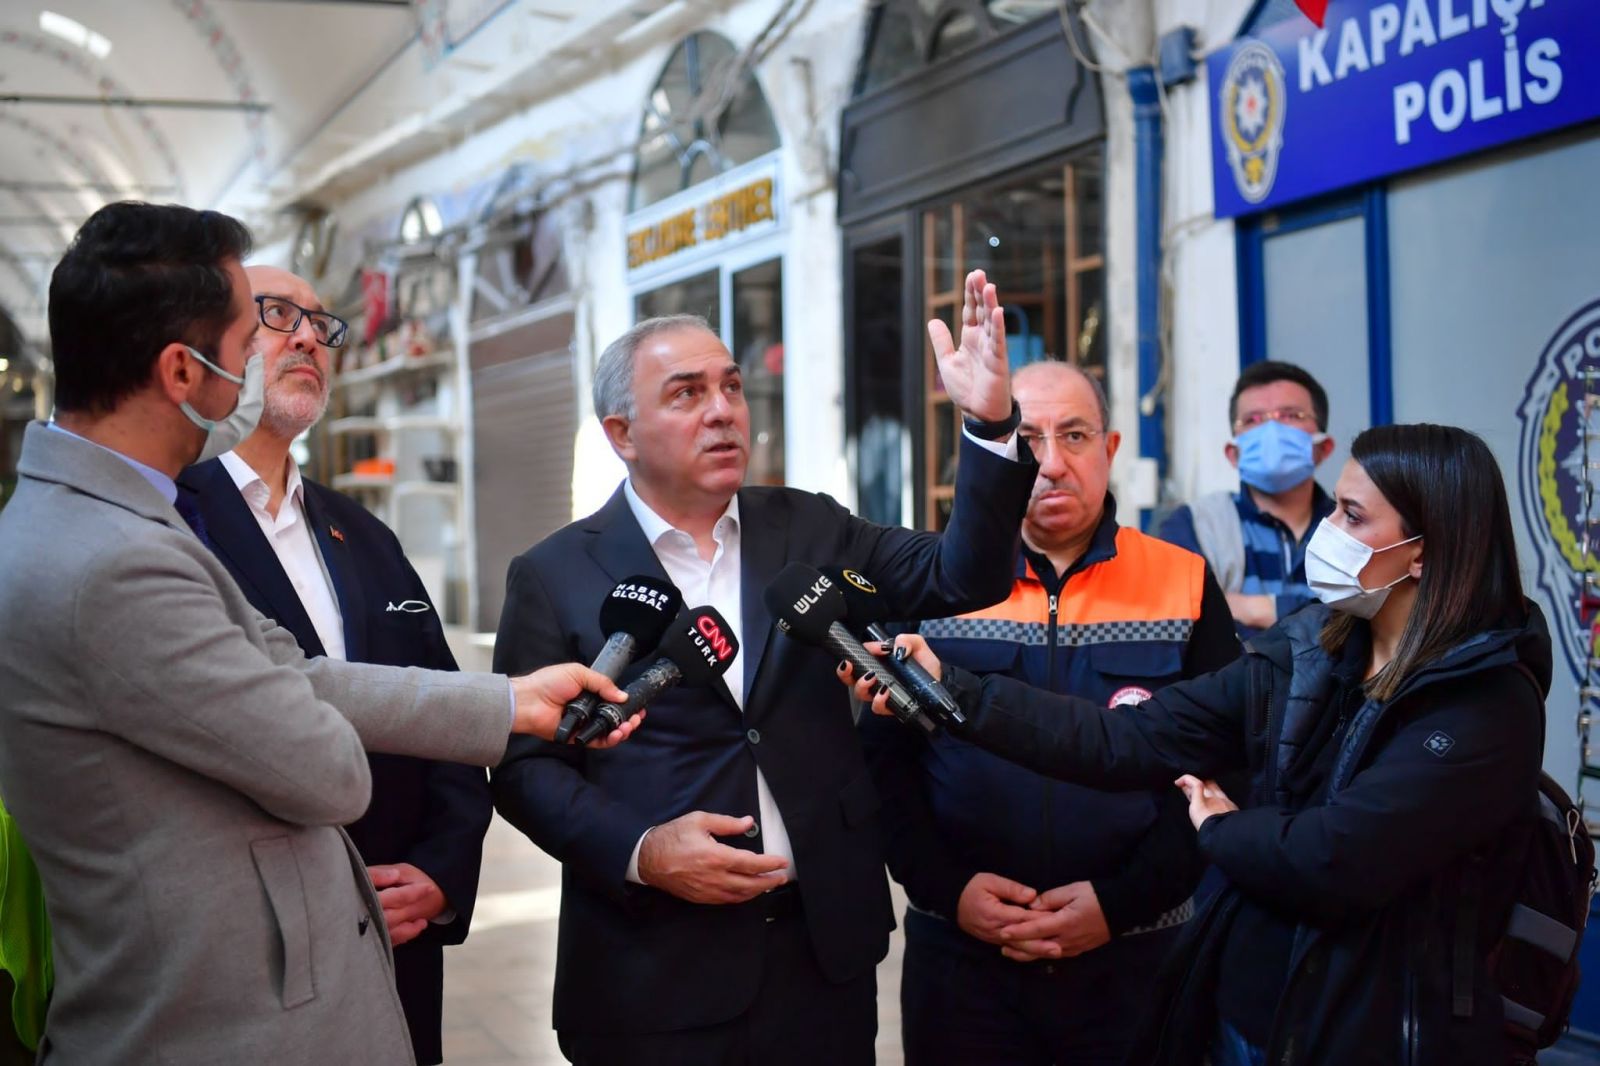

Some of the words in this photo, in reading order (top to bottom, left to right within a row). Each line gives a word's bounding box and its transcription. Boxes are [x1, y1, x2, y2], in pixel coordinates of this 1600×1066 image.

[1298, 0, 1547, 92] KAPALIÇ
[1393, 35, 1563, 145] POLİS
[612, 590, 663, 611] GLOBAL
[616, 583, 669, 603] HABER
[696, 615, 733, 661] CNN
